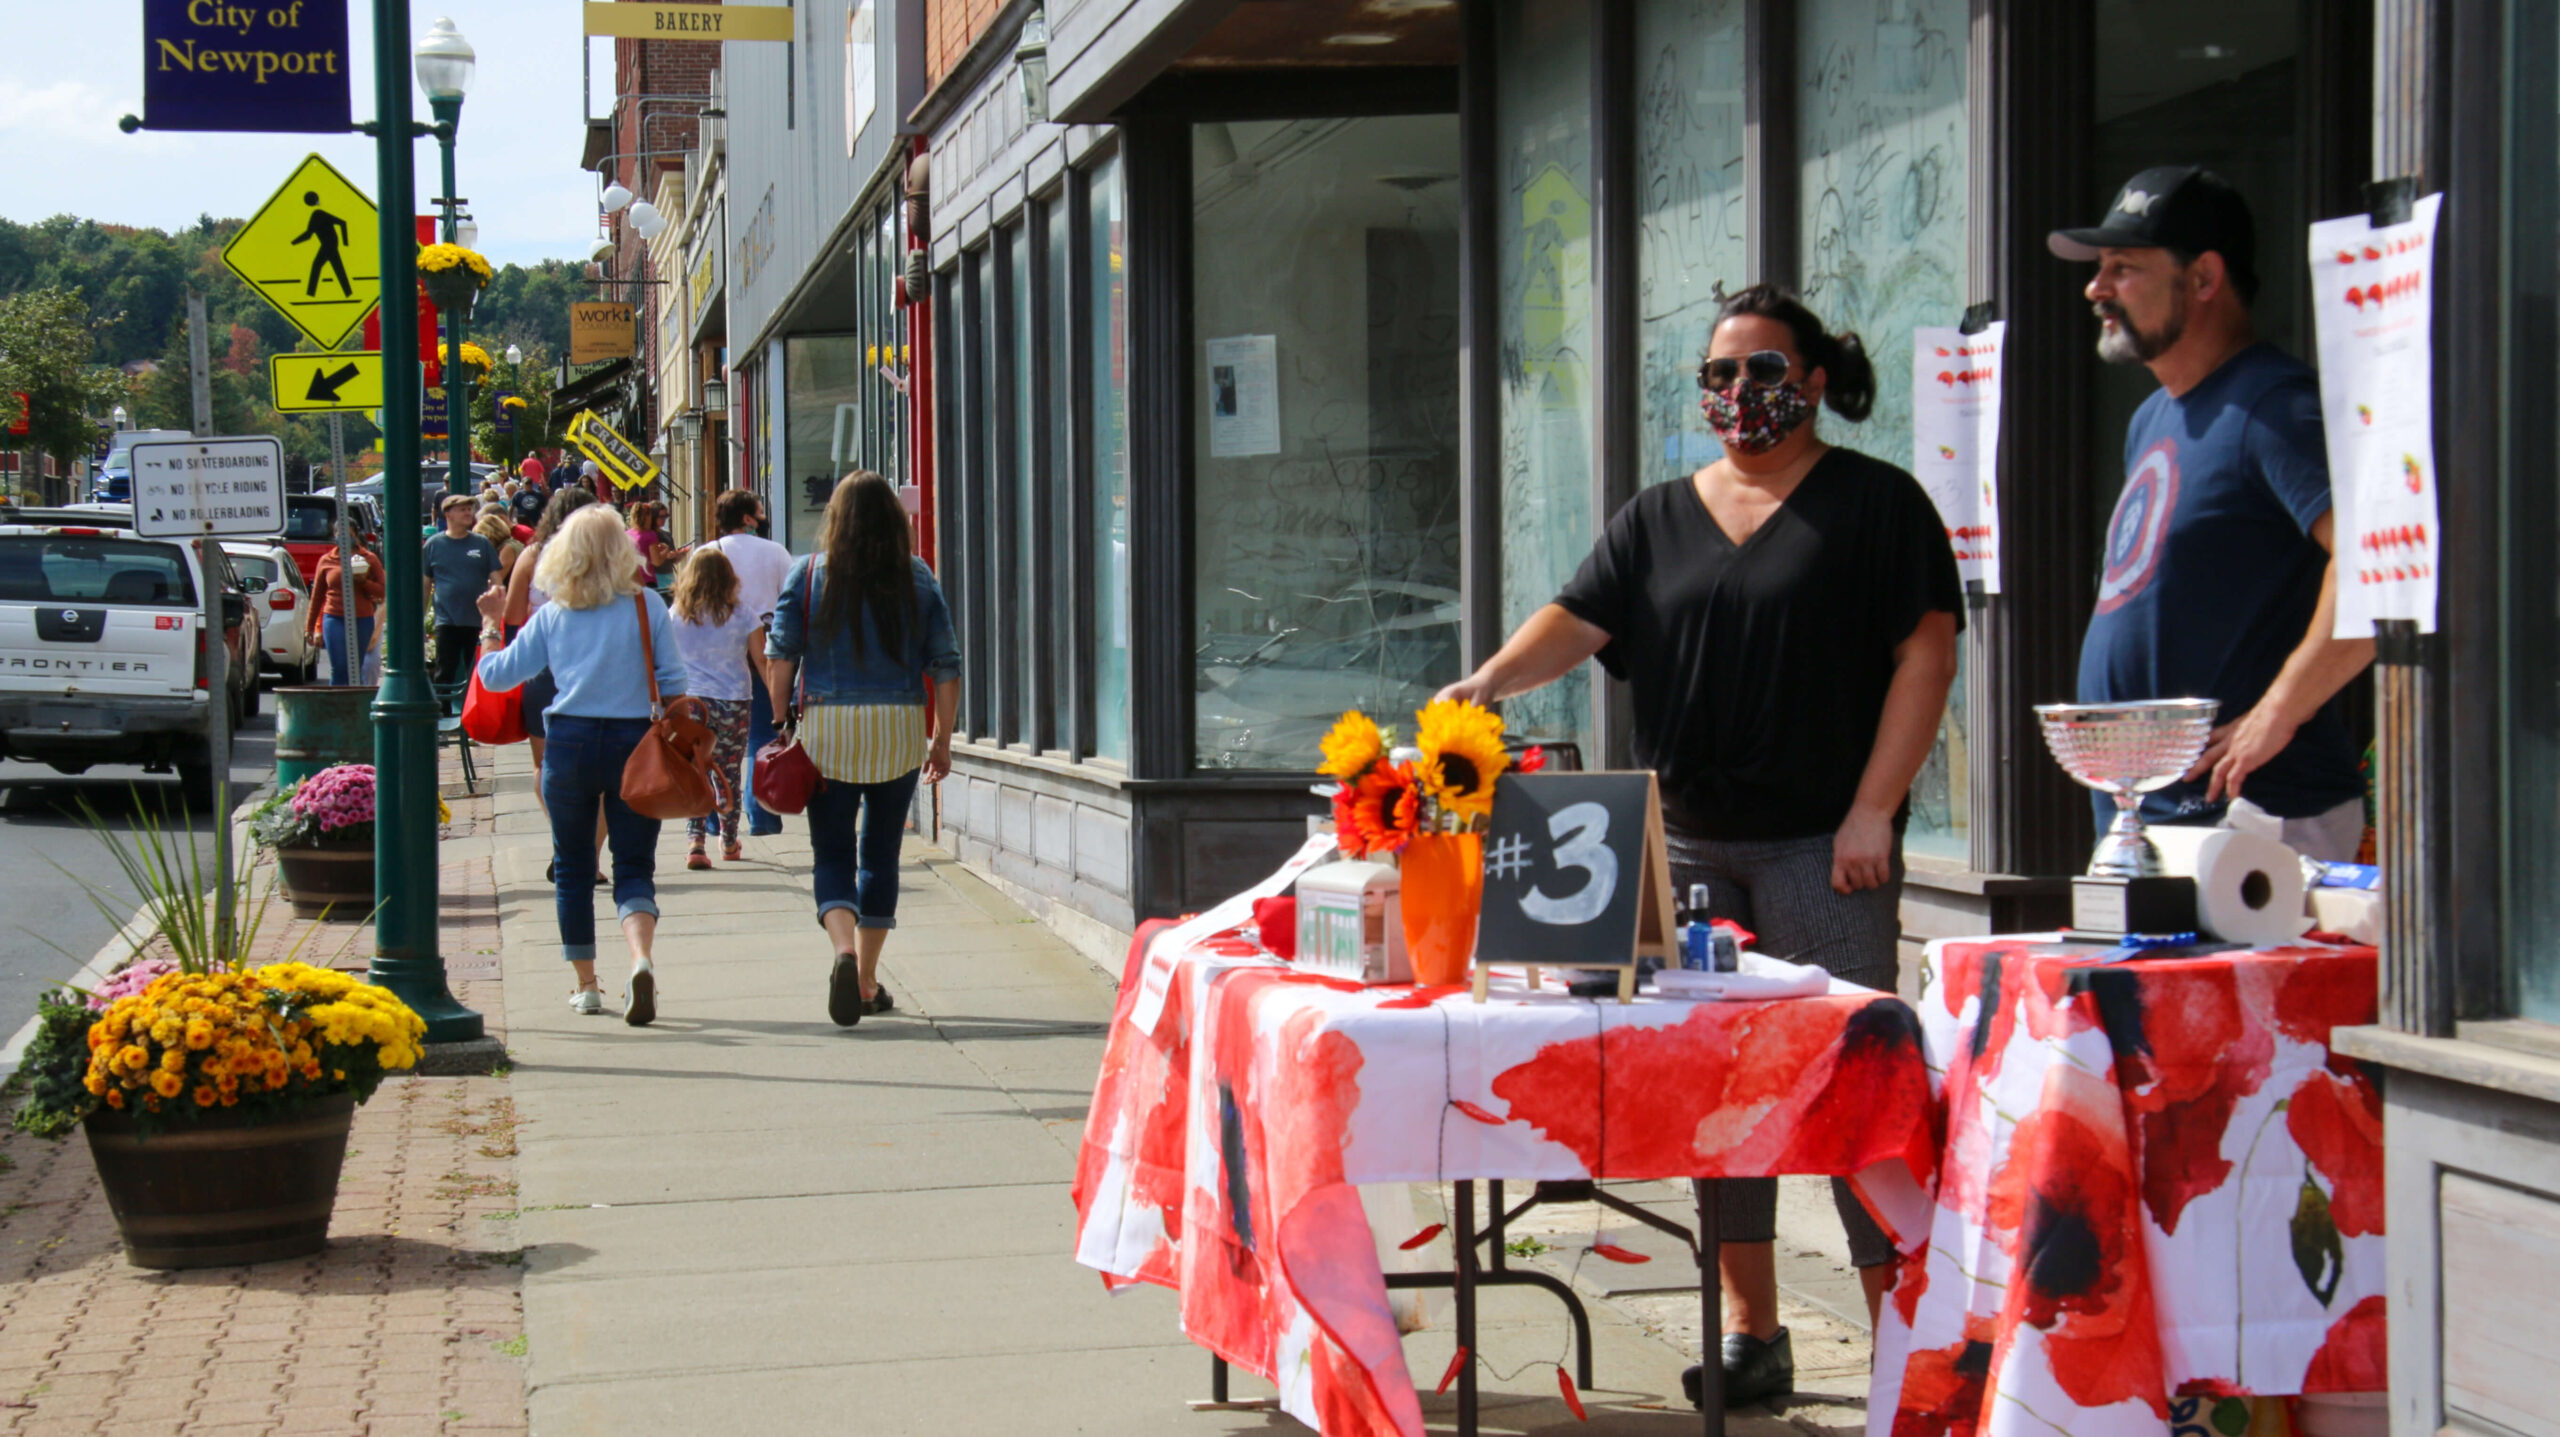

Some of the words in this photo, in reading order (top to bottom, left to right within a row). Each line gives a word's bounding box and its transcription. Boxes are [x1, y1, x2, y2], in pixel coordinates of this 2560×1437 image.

[187, 0, 256, 35] City
[267, 1, 304, 28] of
[655, 11, 723, 32] BAKERY
[156, 39, 338, 84] Newport
[578, 307, 622, 322] work
[589, 420, 645, 472] CRAFTS
[169, 459, 183, 471] NO
[171, 484, 184, 496] NO
[233, 480, 267, 493] RIDING
[172, 509, 186, 521] NO
